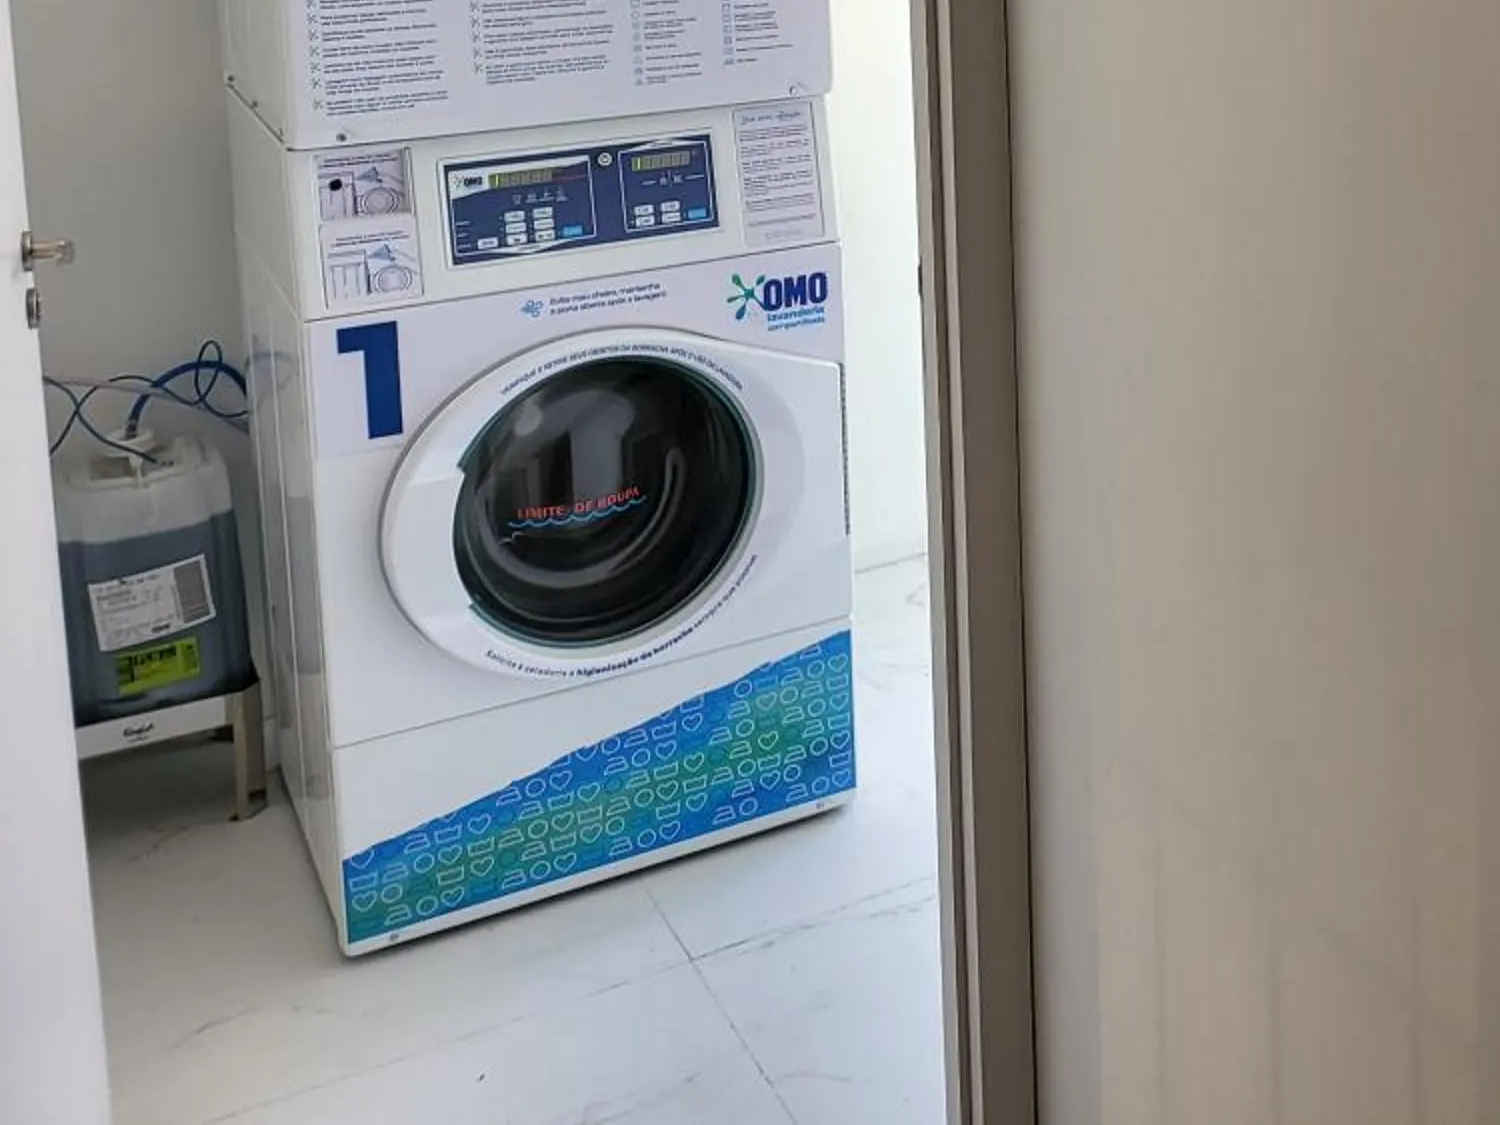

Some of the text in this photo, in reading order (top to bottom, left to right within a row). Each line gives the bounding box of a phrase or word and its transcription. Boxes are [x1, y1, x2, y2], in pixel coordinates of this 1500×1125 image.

[763, 272, 828, 312] OMO
[336, 321, 404, 440] 1
[517, 505, 566, 520] LIMITE
